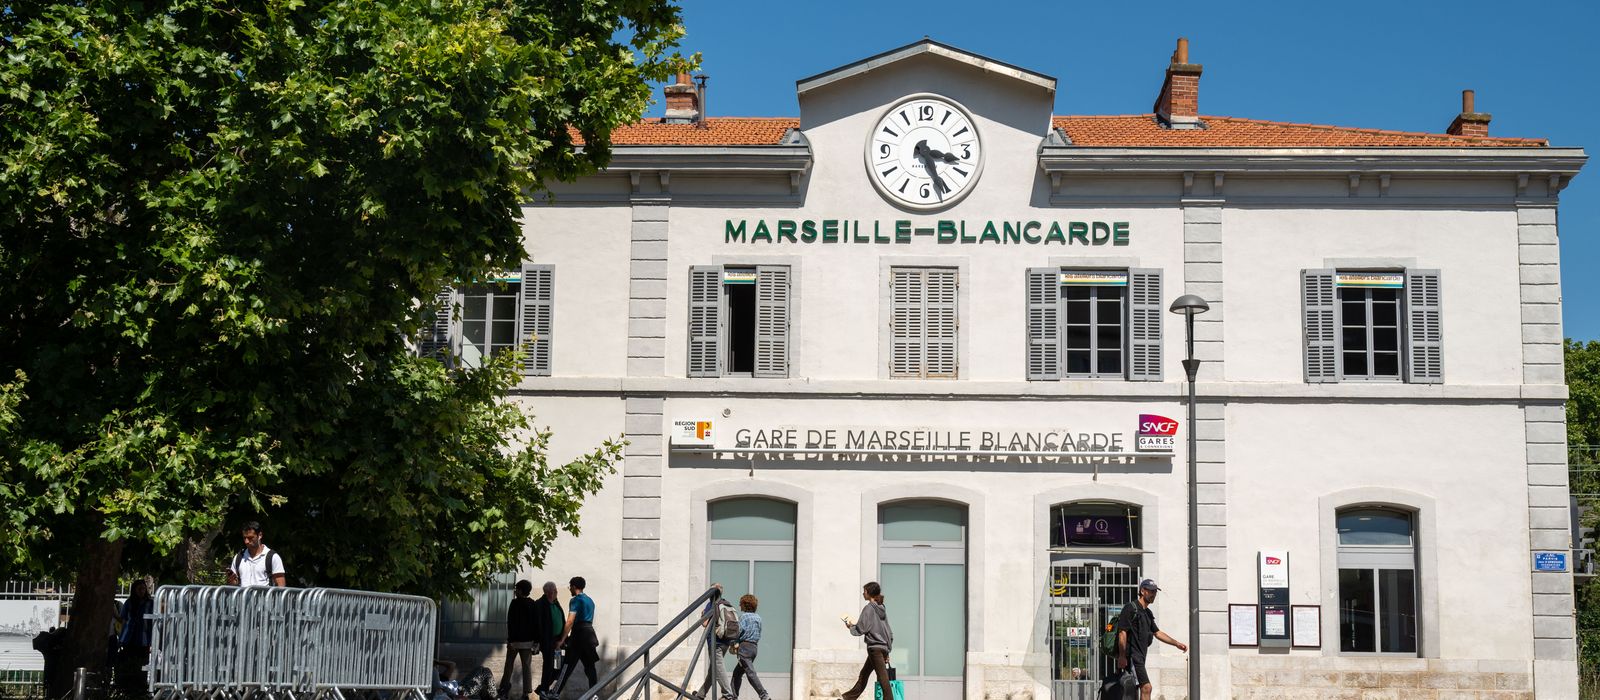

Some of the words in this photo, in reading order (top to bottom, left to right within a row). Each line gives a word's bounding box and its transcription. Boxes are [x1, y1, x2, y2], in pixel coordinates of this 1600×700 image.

[918, 105, 934, 121] 12
[880, 144, 890, 159] 9
[960, 144, 970, 159] 3
[919, 183, 930, 198] 6
[724, 219, 1130, 245] MARSEILLE-BLANCARDE
[1140, 421, 1177, 432] SNCF
[735, 429, 797, 448] GARE
[805, 429, 837, 448] DE
[845, 430, 971, 450] MARSEILLE
[980, 431, 1123, 452] BLANCARDE
